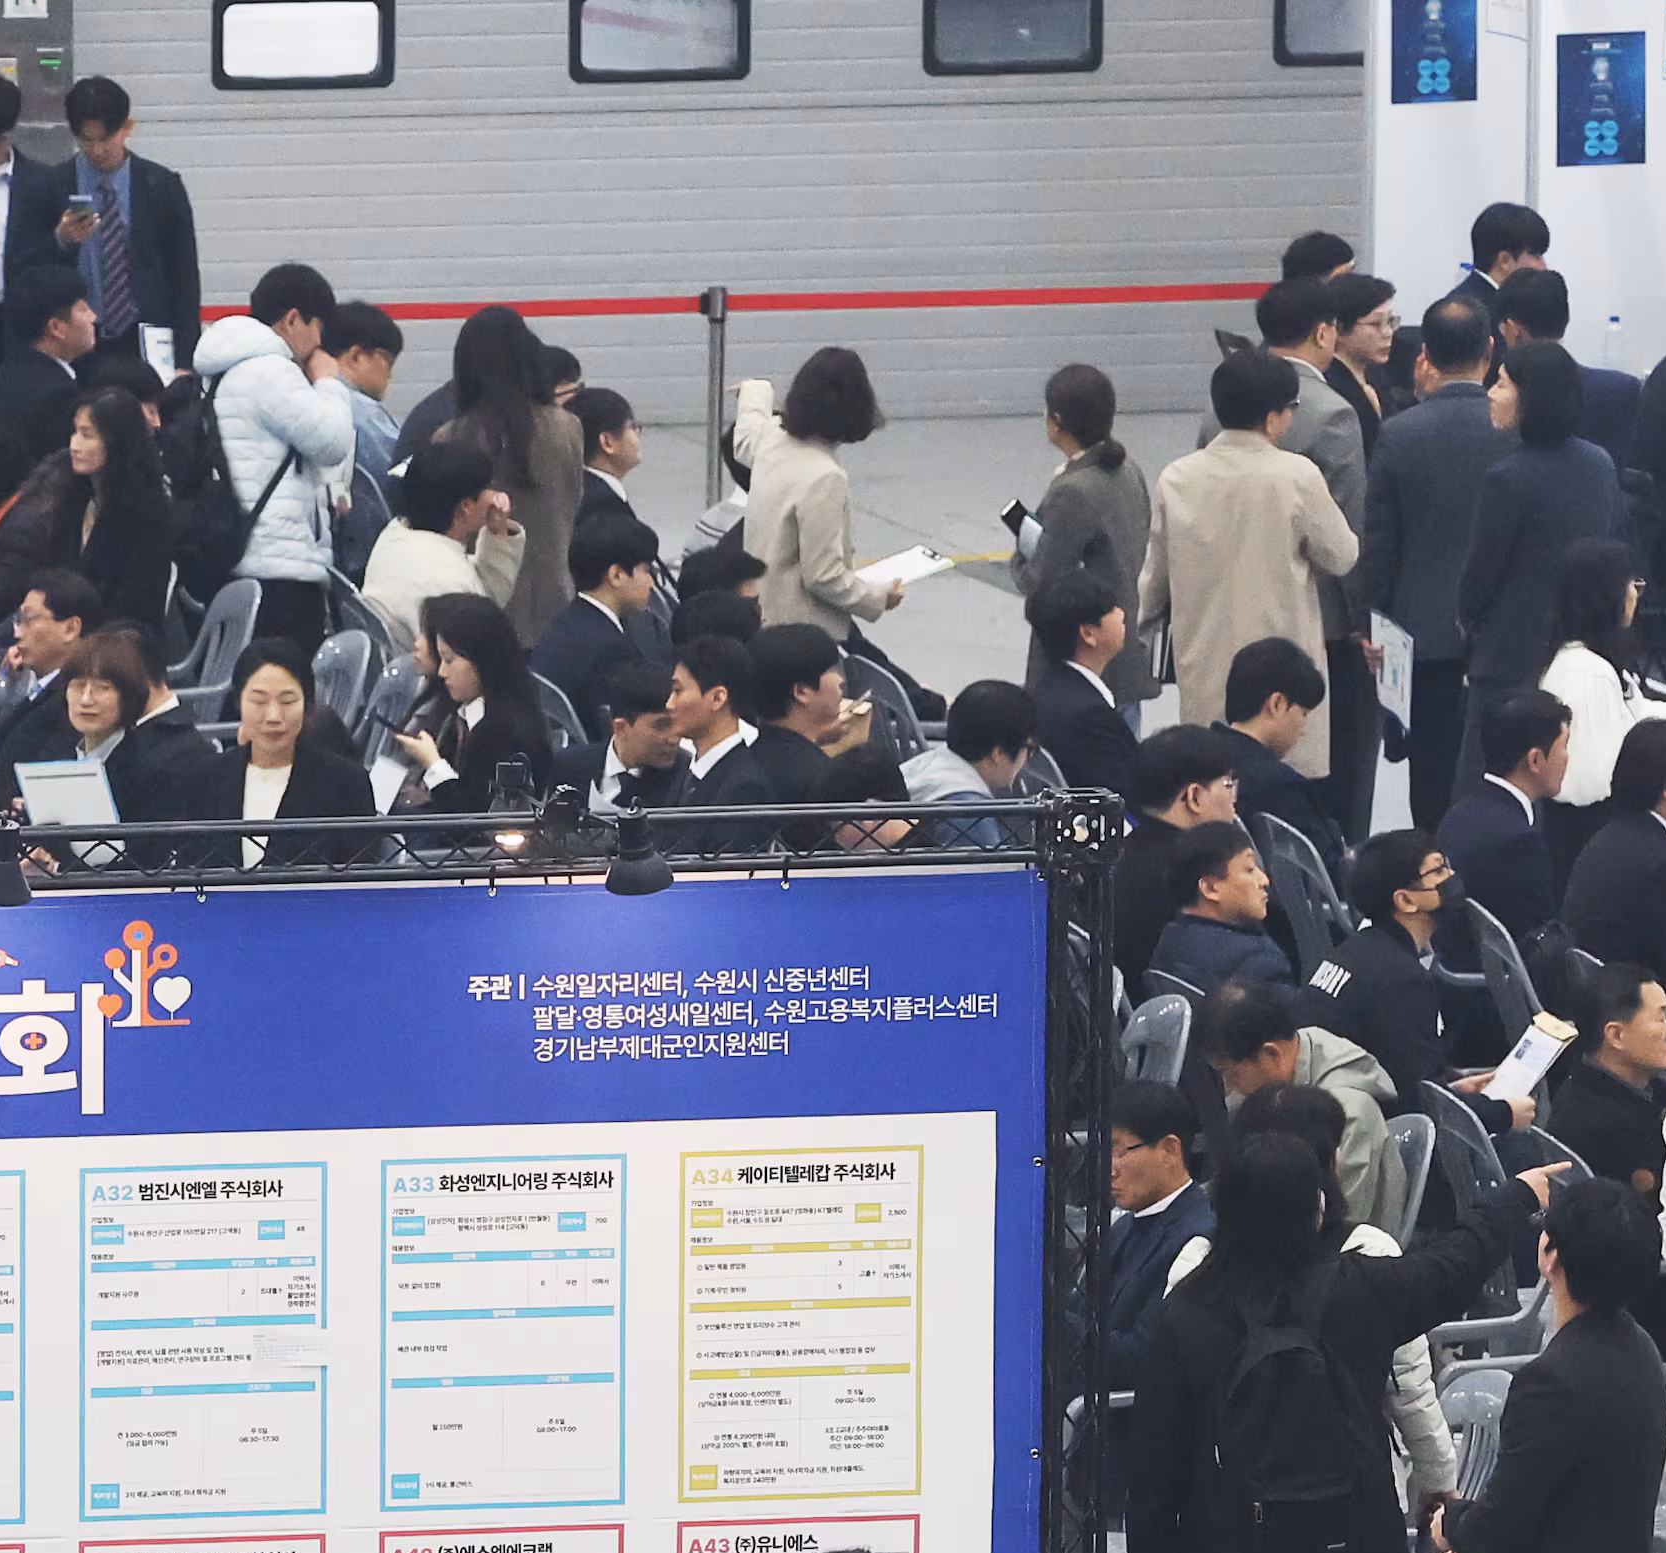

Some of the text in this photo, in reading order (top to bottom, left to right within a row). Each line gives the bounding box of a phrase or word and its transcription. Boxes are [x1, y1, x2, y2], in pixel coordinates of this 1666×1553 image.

[467, 965, 870, 1001] 주관 수원일자리센터, 수원시 신중년센터
[764, 993, 998, 1025] 수원고용복지플러스센터
[532, 1030, 790, 1062] 경기남부제대군인지원센터
[393, 1170, 614, 1192] A33 화성엔지니어링 주식회사
[691, 1168, 734, 1185] A34
[833, 1162, 896, 1182] 주식회사
[92, 1179, 284, 1201] A32 범진시엔엘 주식회사
